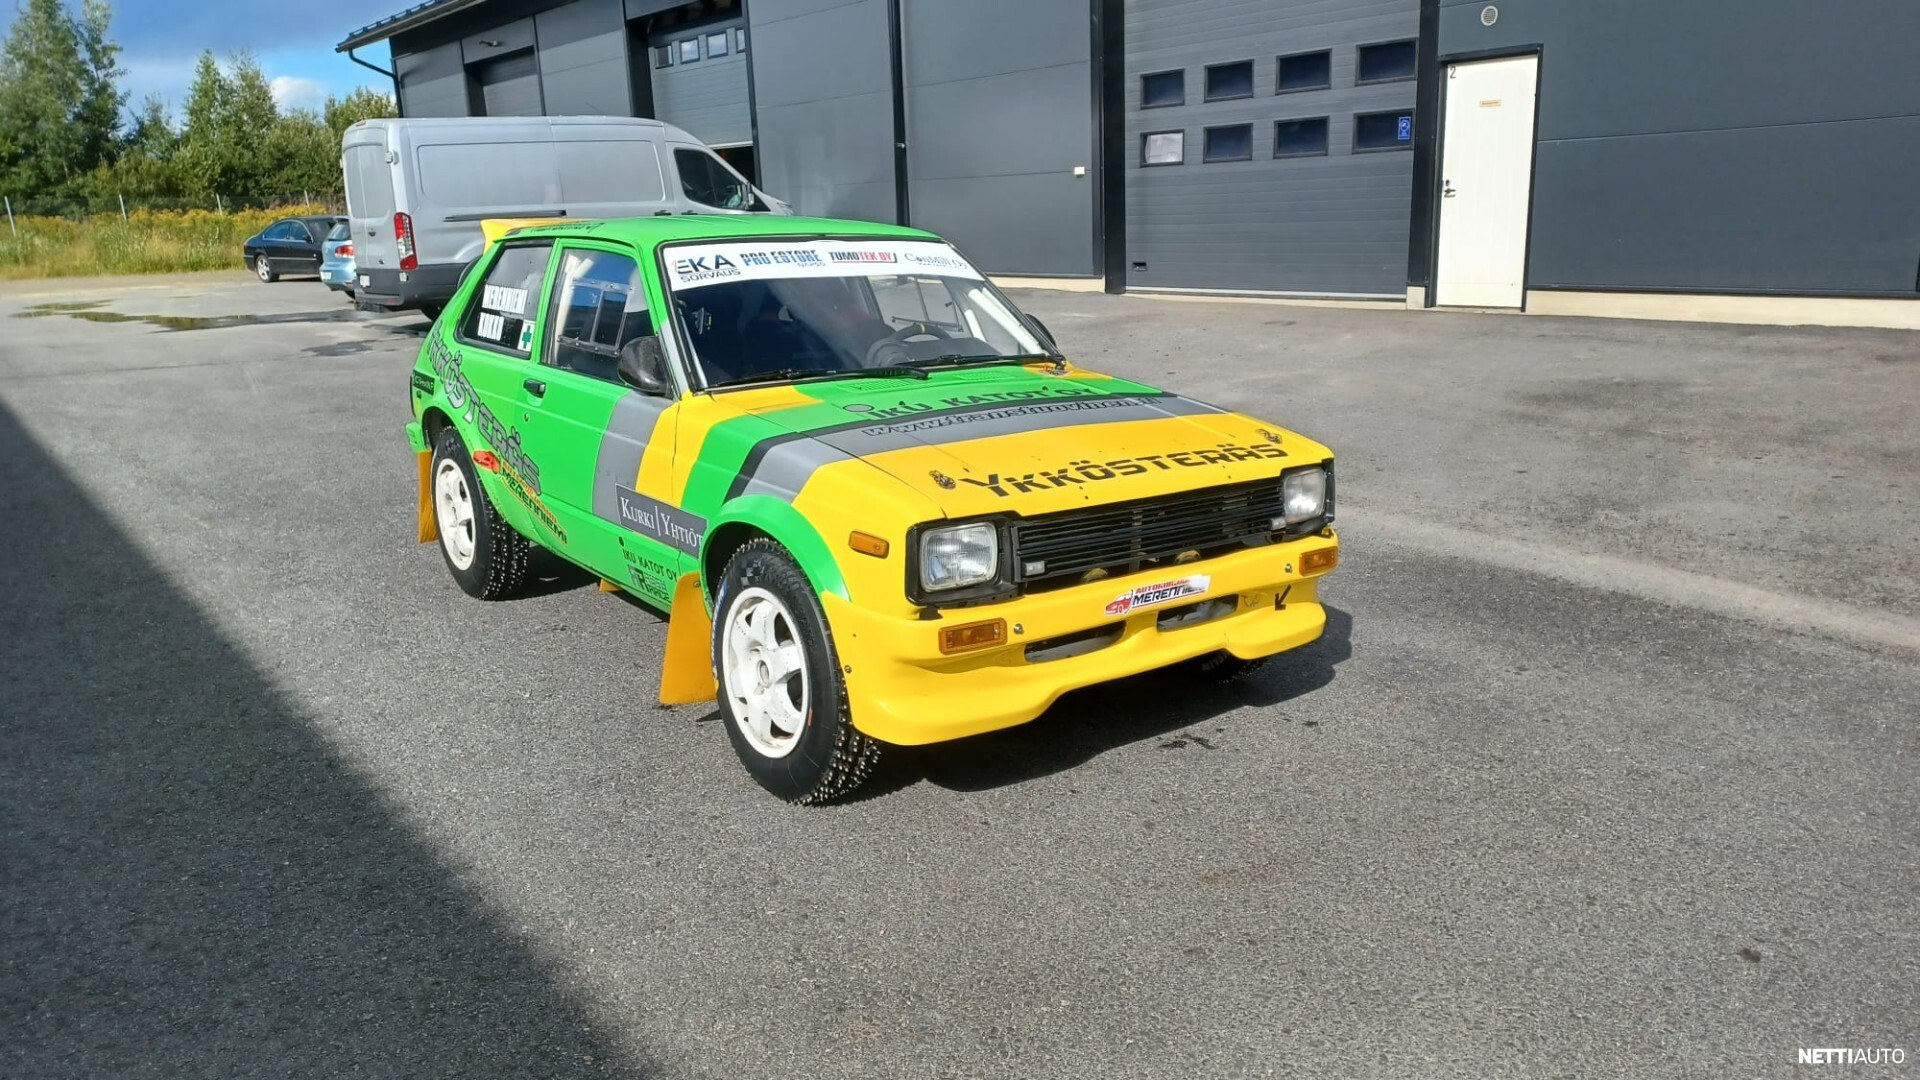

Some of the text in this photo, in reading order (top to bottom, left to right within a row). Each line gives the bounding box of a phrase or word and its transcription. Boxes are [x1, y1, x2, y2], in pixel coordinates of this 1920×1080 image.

[672, 254, 737, 274] EKA
[828, 251, 894, 261] TUMOTEK OY
[680, 269, 741, 283] SORVAUS
[958, 443, 1289, 498] YKKÖSTERÄS
[638, 555, 665, 578] KATOT
[665, 567, 678, 583] OY
